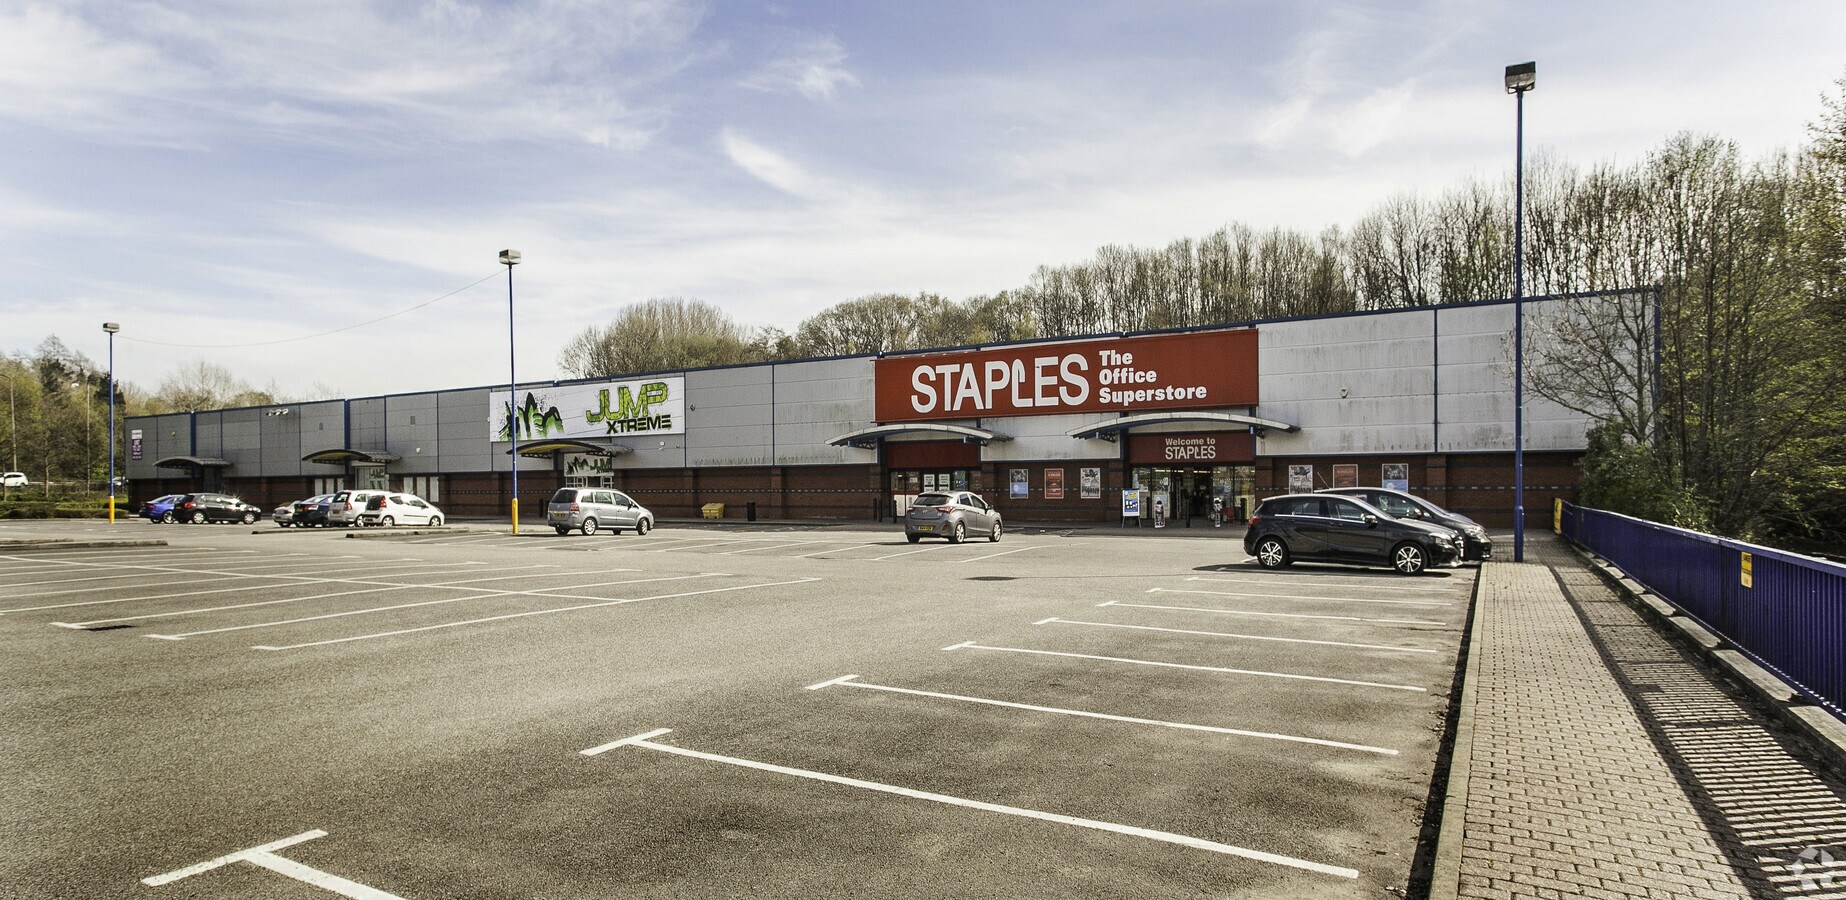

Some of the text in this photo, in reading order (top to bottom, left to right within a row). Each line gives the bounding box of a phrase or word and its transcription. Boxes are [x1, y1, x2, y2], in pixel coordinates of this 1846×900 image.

[1099, 350, 1133, 367] The
[911, 353, 1090, 413] STAPLES
[1099, 367, 1157, 386] Office
[585, 381, 668, 423] JUMP
[1099, 385, 1207, 406] Superstore
[606, 414, 672, 434] XTREME
[1165, 437, 1216, 446] Welcome to
[1165, 445, 1216, 460] STAPLES
